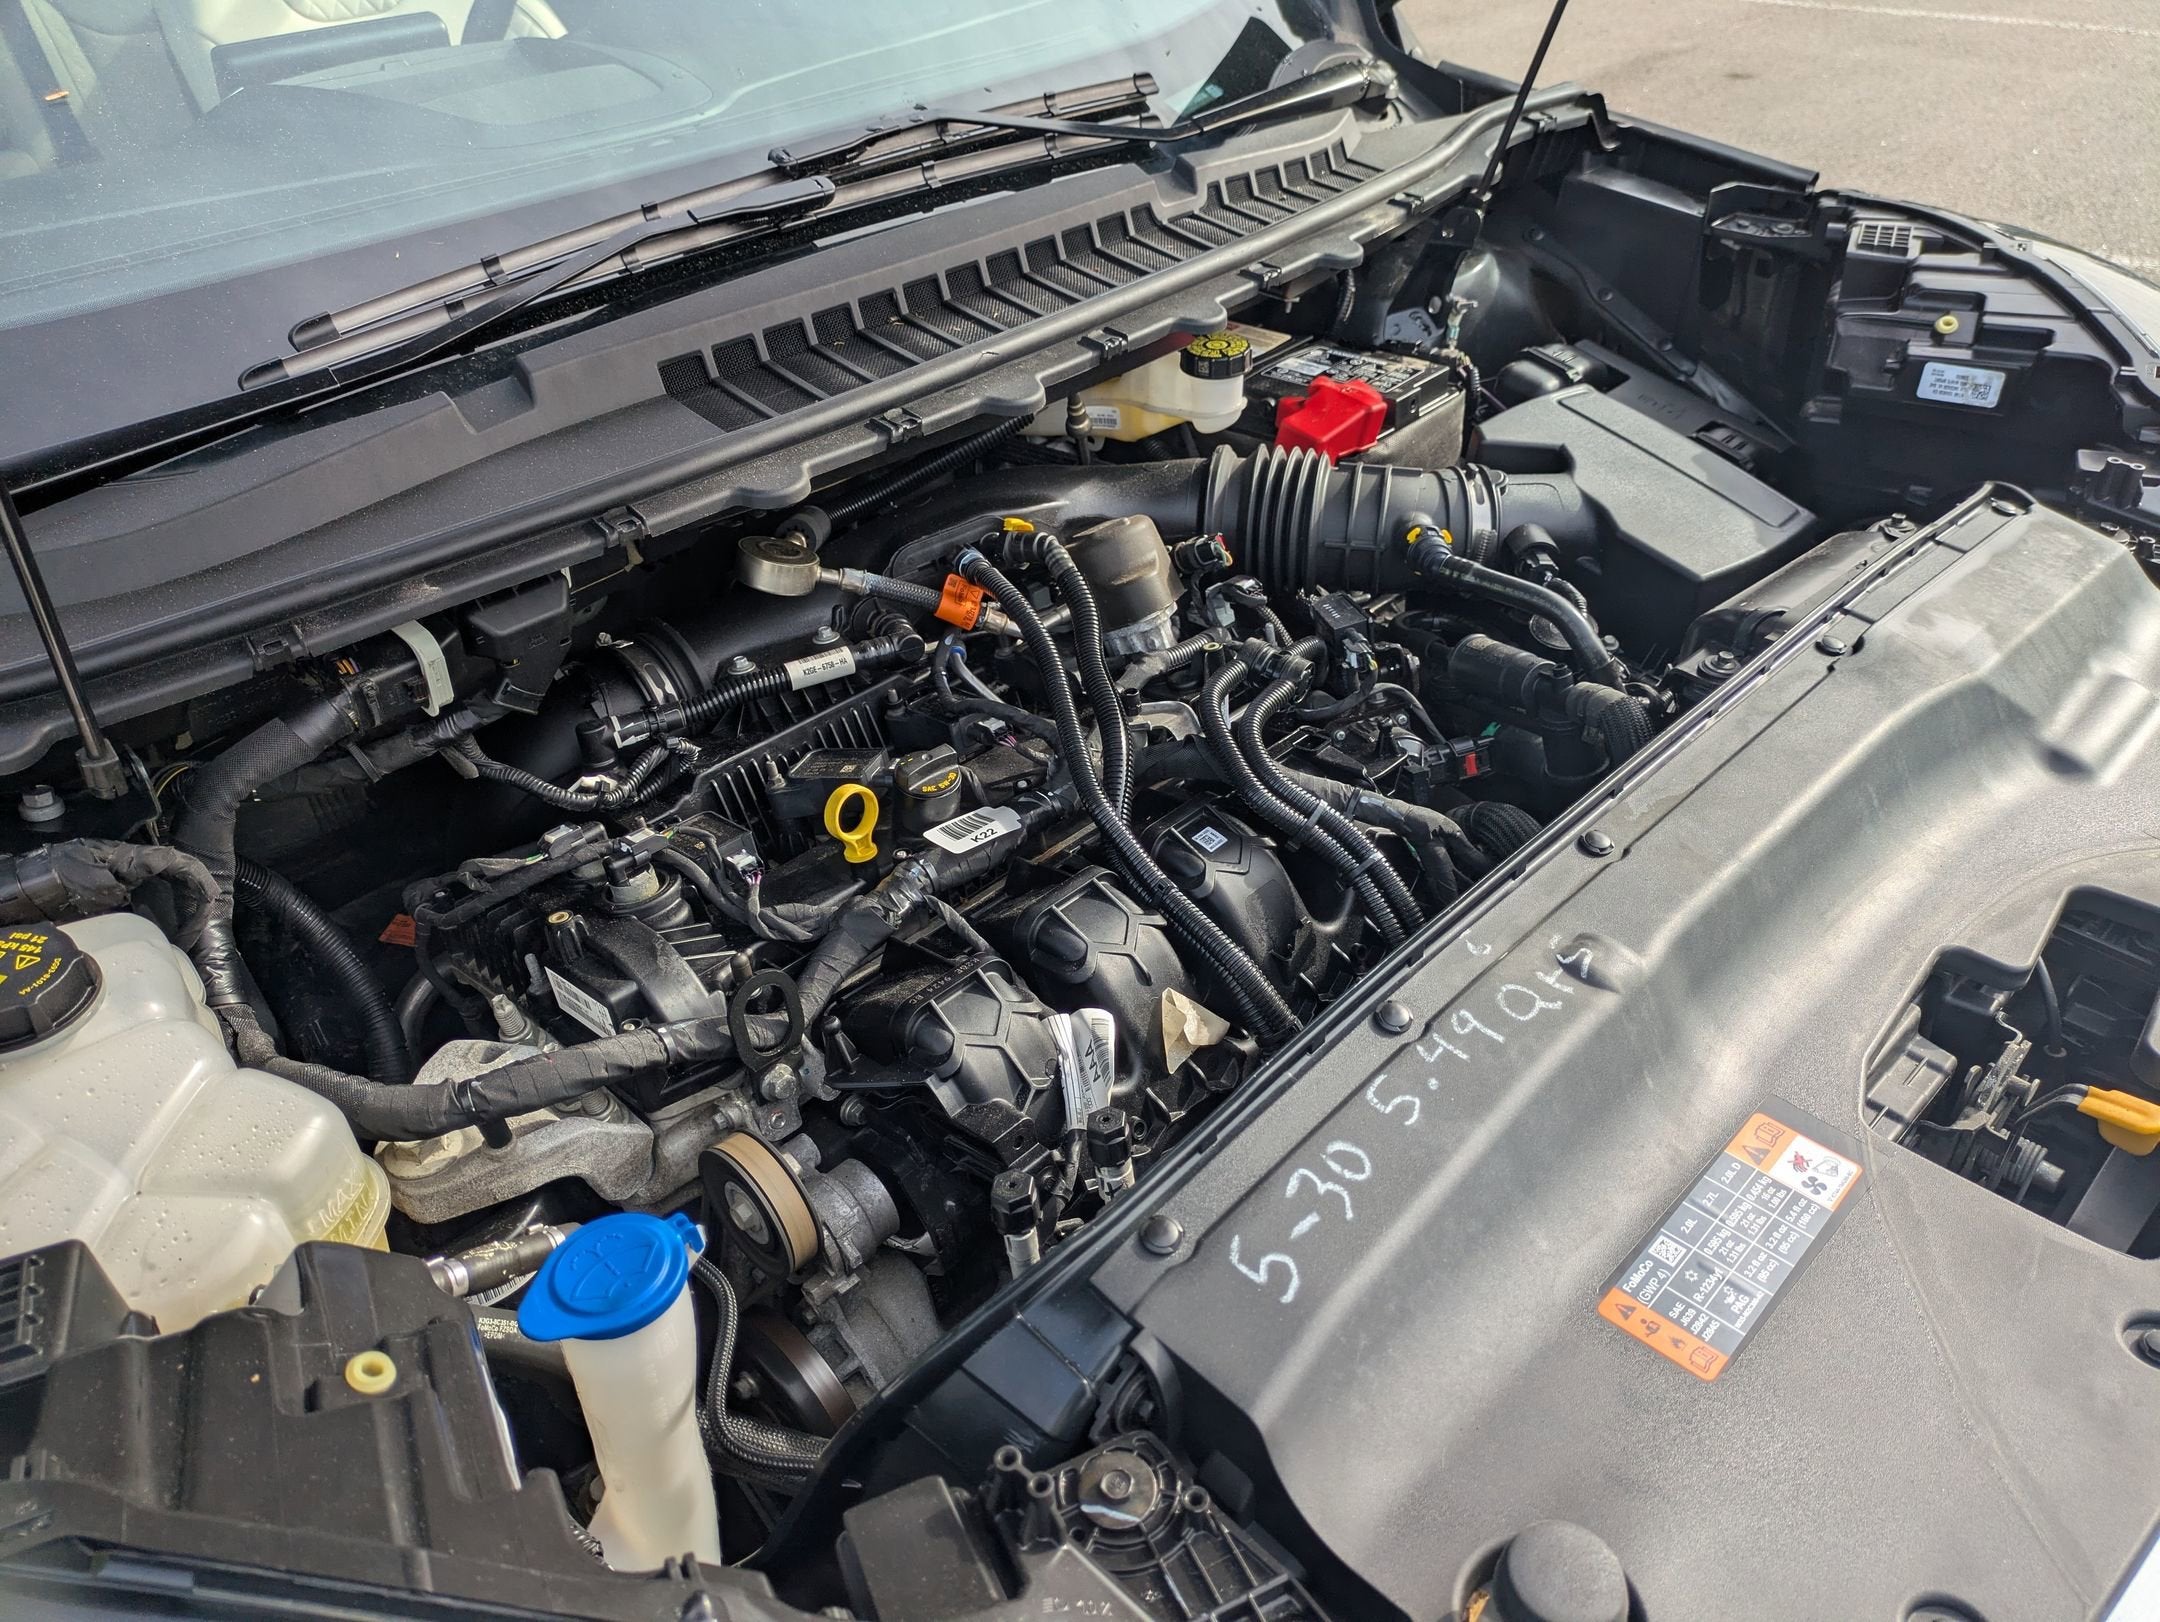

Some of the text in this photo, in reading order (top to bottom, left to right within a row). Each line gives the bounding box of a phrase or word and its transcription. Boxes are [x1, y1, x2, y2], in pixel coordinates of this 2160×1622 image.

[970, 828, 998, 844] K22
[9, 932, 48, 944] 21 psi
[19, 943, 42, 953] 145
[1230, 1141, 1372, 1303] 5-30
[1365, 1009, 1504, 1126] 5.49
[1732, 1162, 1742, 1170] D
[1758, 1175, 1773, 1187] kg
[1702, 1190, 1719, 1207] 2.7L
[1738, 1201, 1752, 1213] kg
[1807, 1204, 1821, 1217] cc)
[1680, 1217, 1698, 1235] 2.0L
[1704, 1228, 1731, 1256] 0.595 kg
[1765, 1237, 1779, 1250] 3.2
[1786, 1231, 1801, 1245] cc)
[1744, 1265, 1757, 1278] 3.2
[1765, 1259, 1780, 1273] cc)
[1623, 1260, 1654, 1293] FoMoCo
[1637, 1268, 1671, 1305] (GWP 4)
[1693, 1267, 1726, 1305] R-1234yf
[1669, 1301, 1685, 1319] SAE
[1731, 1294, 1750, 1315] PAG
[1681, 1308, 1696, 1326] J639
